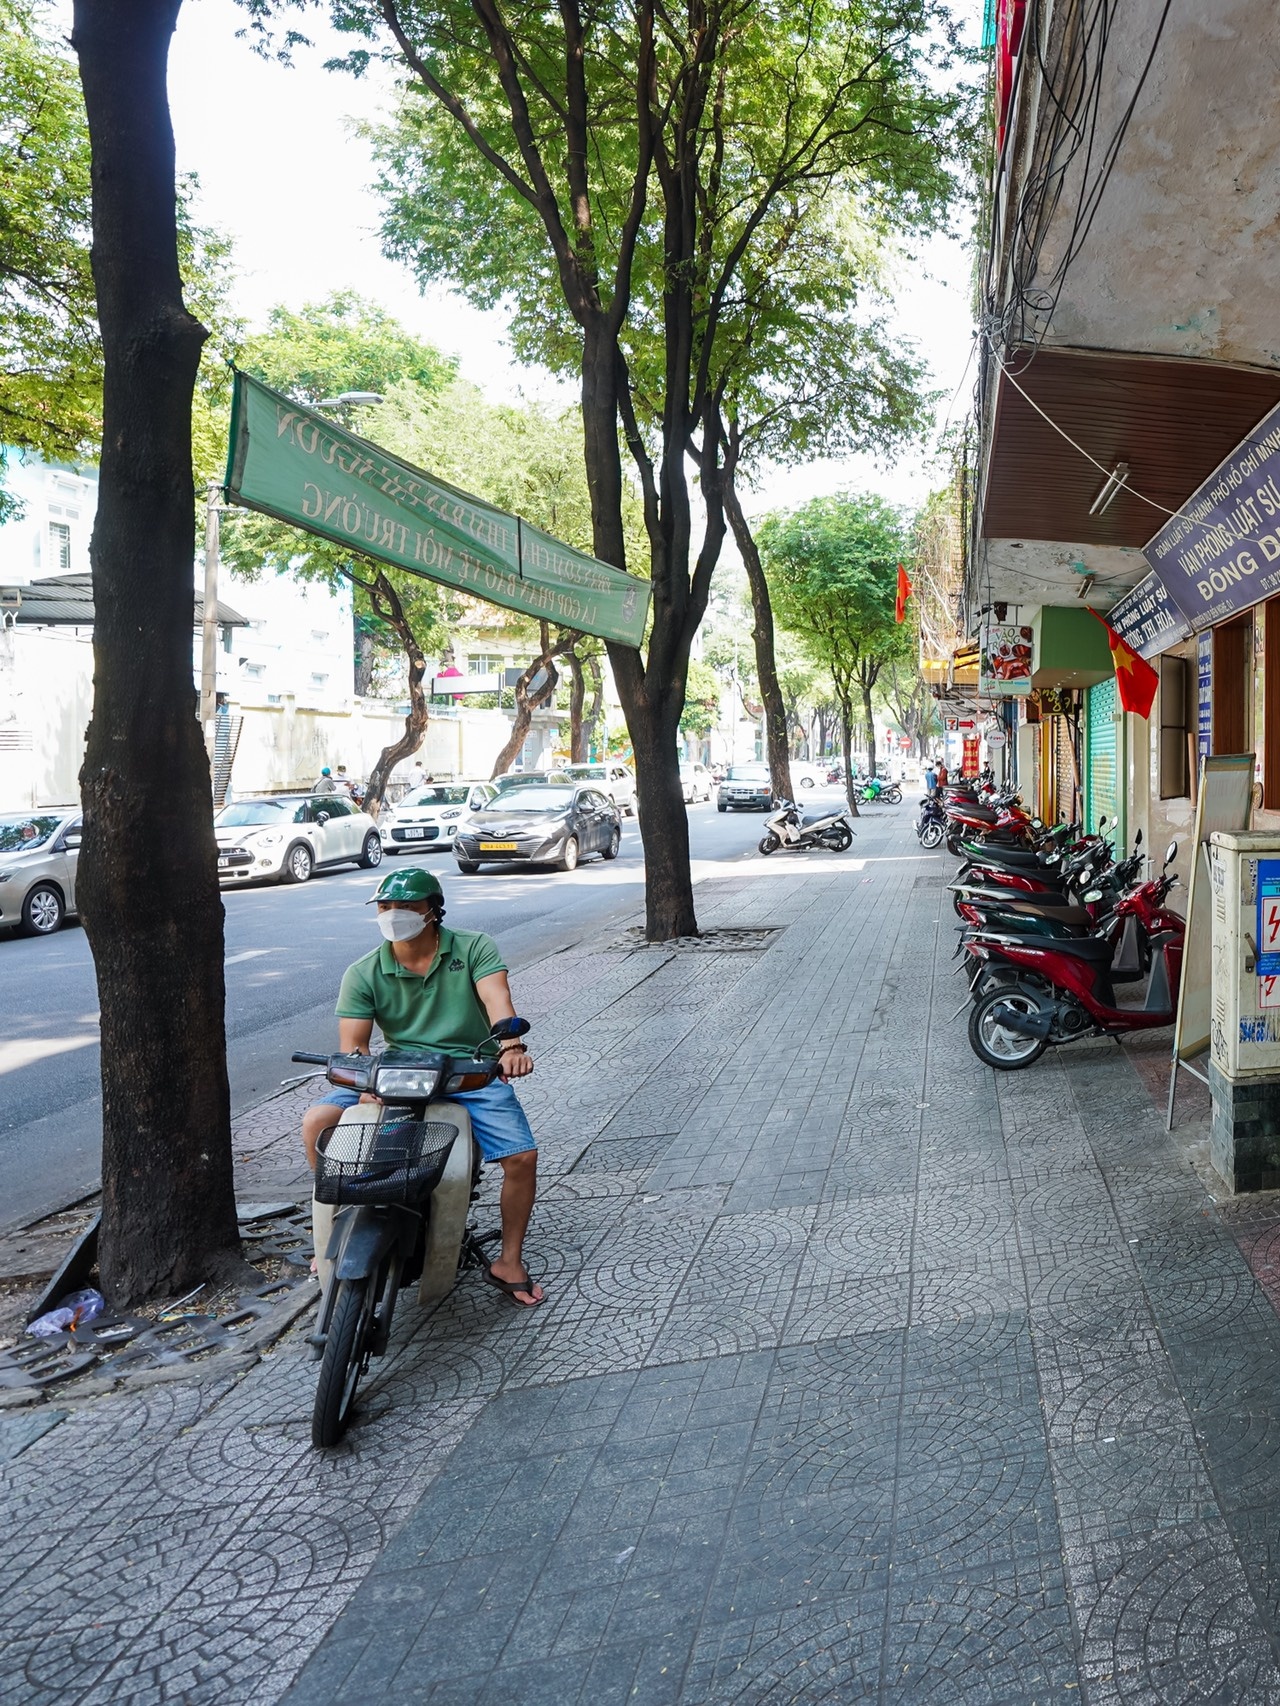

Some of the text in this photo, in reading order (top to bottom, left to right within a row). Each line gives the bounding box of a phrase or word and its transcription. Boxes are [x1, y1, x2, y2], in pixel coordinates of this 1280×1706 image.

[1189, 497, 1215, 524] THÀNH
[1210, 475, 1230, 505] PHỐ
[1226, 464, 1243, 490] HỒ
[1240, 447, 1260, 477] CHÍ
[1178, 546, 1203, 577] VĂN
[1194, 523, 1235, 567] PHÒNG
[1226, 496, 1263, 540] LUẬT
[1196, 551, 1259, 602] ĐÔNG
[1122, 608, 1141, 629] PHÒNG
[1139, 594, 1156, 616] LUẬT
[1156, 584, 1168, 602] SƯ
[1154, 606, 1176, 632] HÒA
